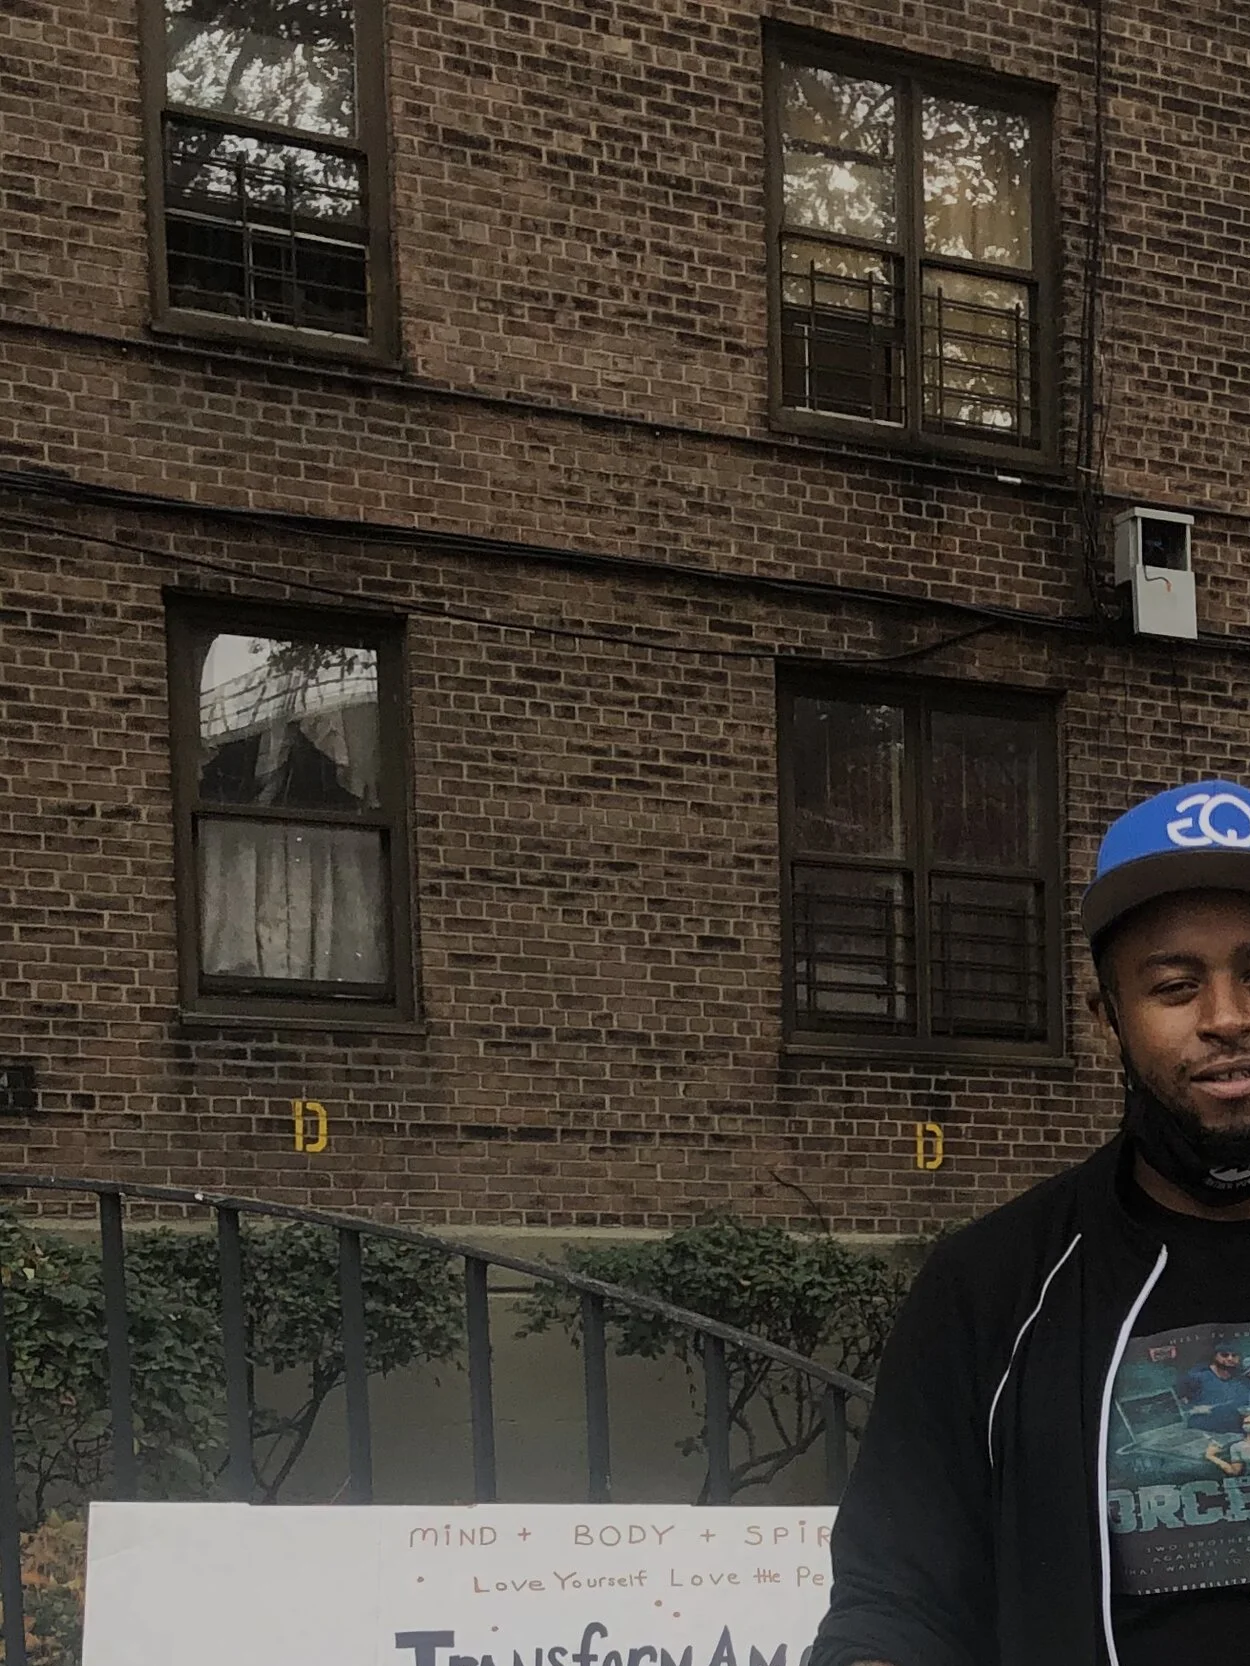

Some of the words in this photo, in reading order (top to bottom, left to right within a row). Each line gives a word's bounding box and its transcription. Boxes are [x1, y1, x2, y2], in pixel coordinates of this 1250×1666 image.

[294, 1100, 328, 1152] D
[916, 1123, 944, 1169] D
[574, 1524, 675, 1548] BODY
[473, 1576, 546, 1594] Love
[552, 1568, 648, 1591] Yourself
[671, 1568, 741, 1587] Love
